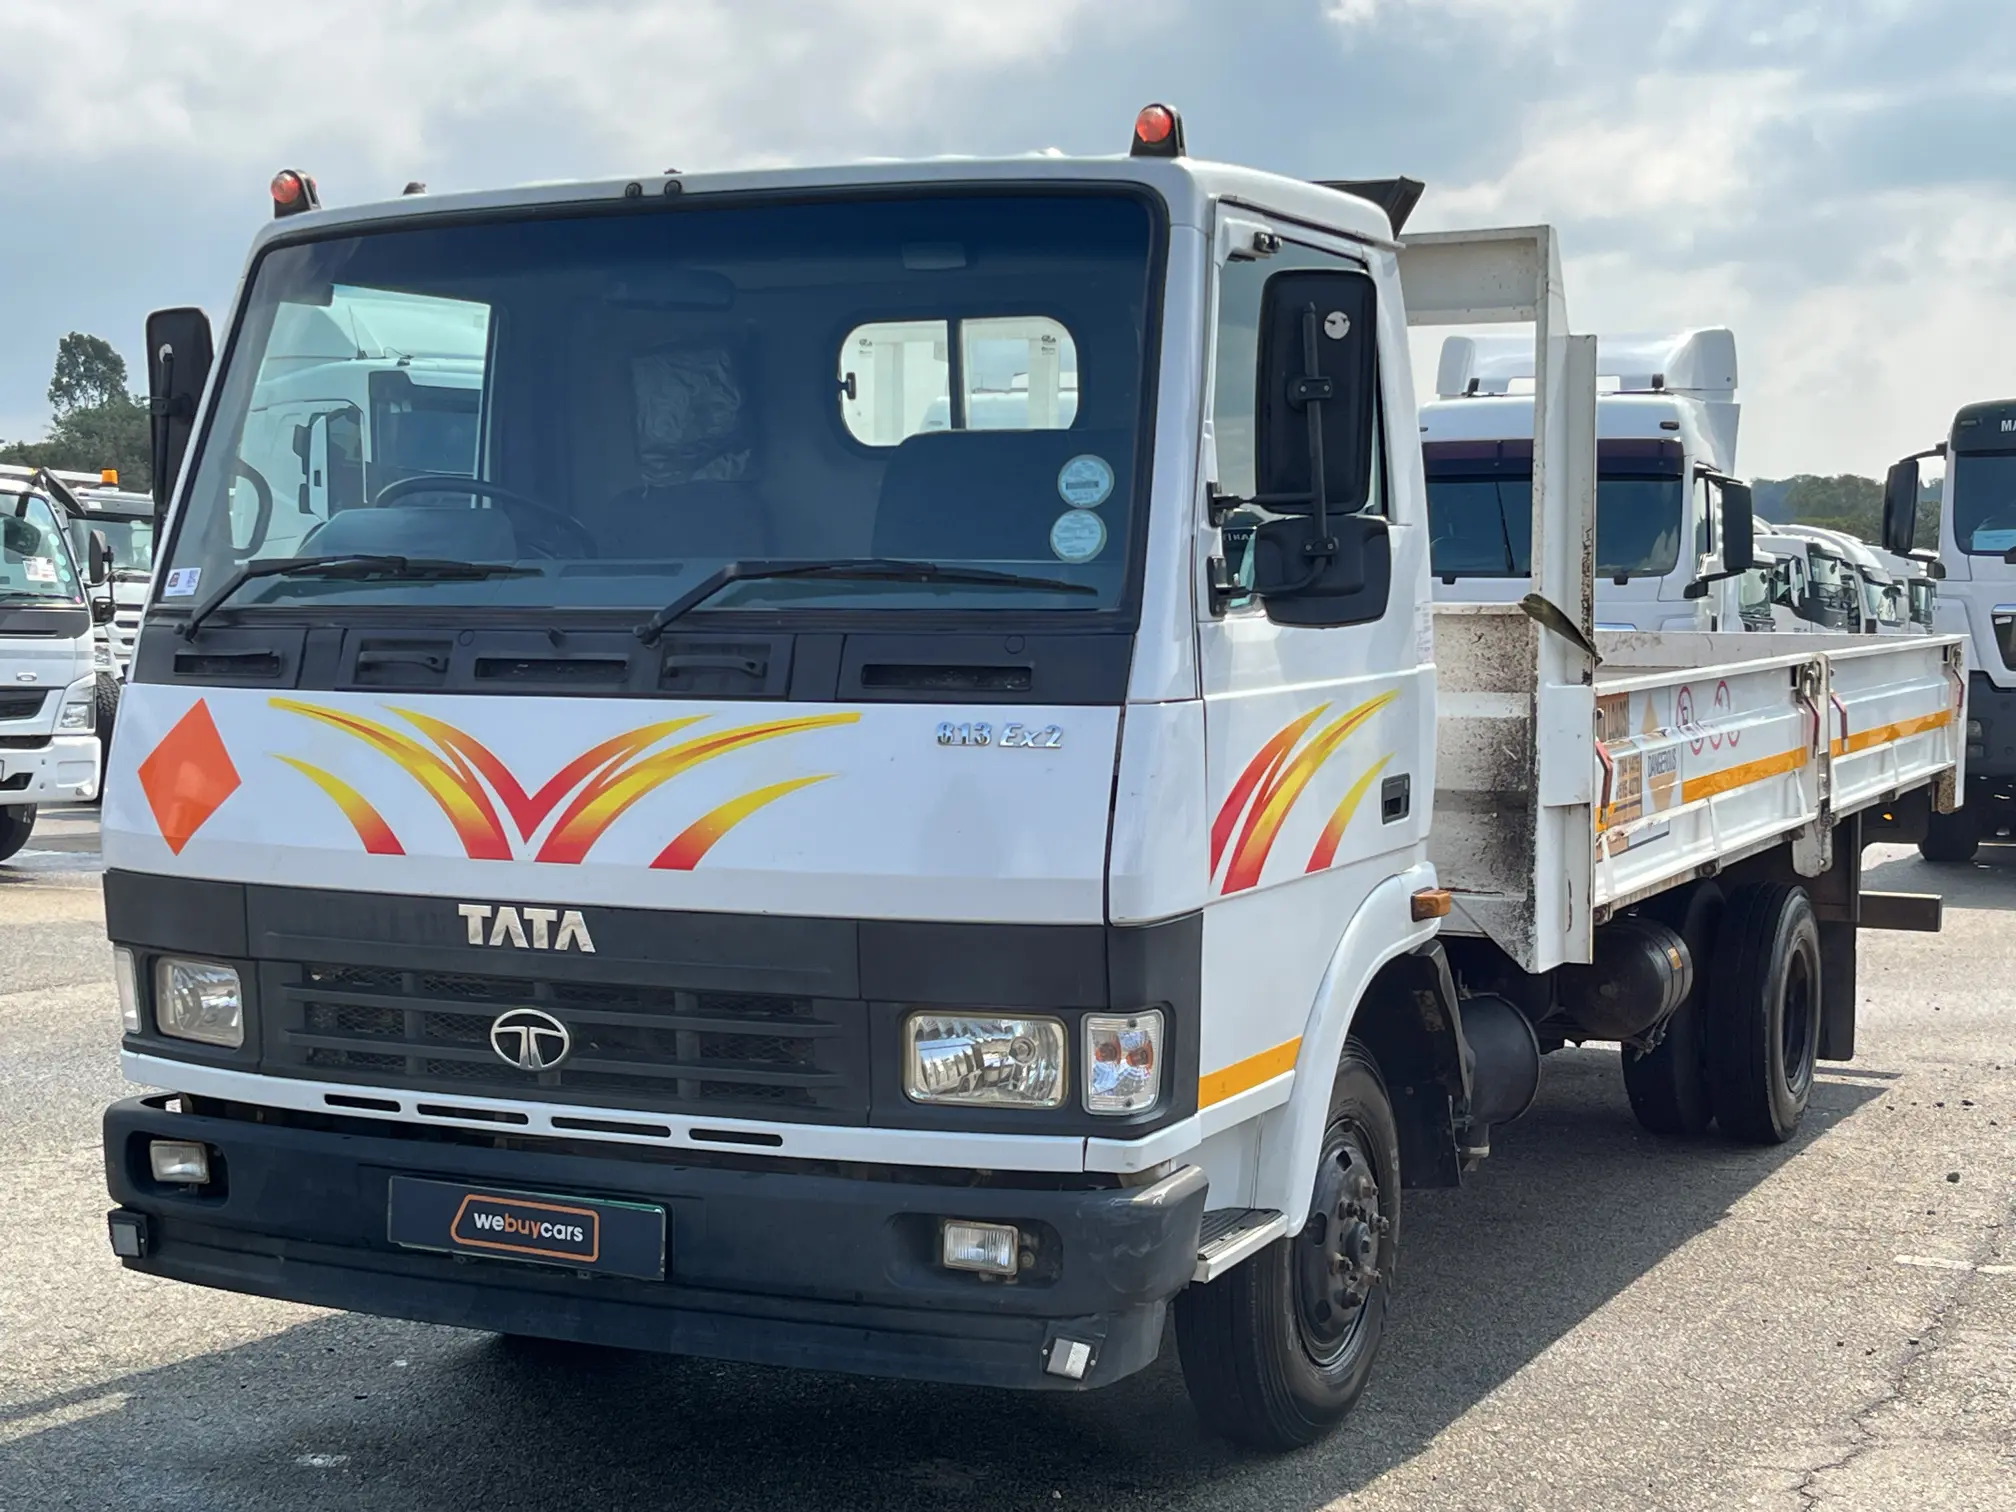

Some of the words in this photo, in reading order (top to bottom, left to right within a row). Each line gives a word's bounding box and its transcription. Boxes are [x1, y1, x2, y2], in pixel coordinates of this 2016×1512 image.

[936, 721, 992, 746] 813
[998, 722, 1062, 748] Ex2
[458, 903, 596, 953] TATA
[473, 1212, 584, 1242] webuycars
